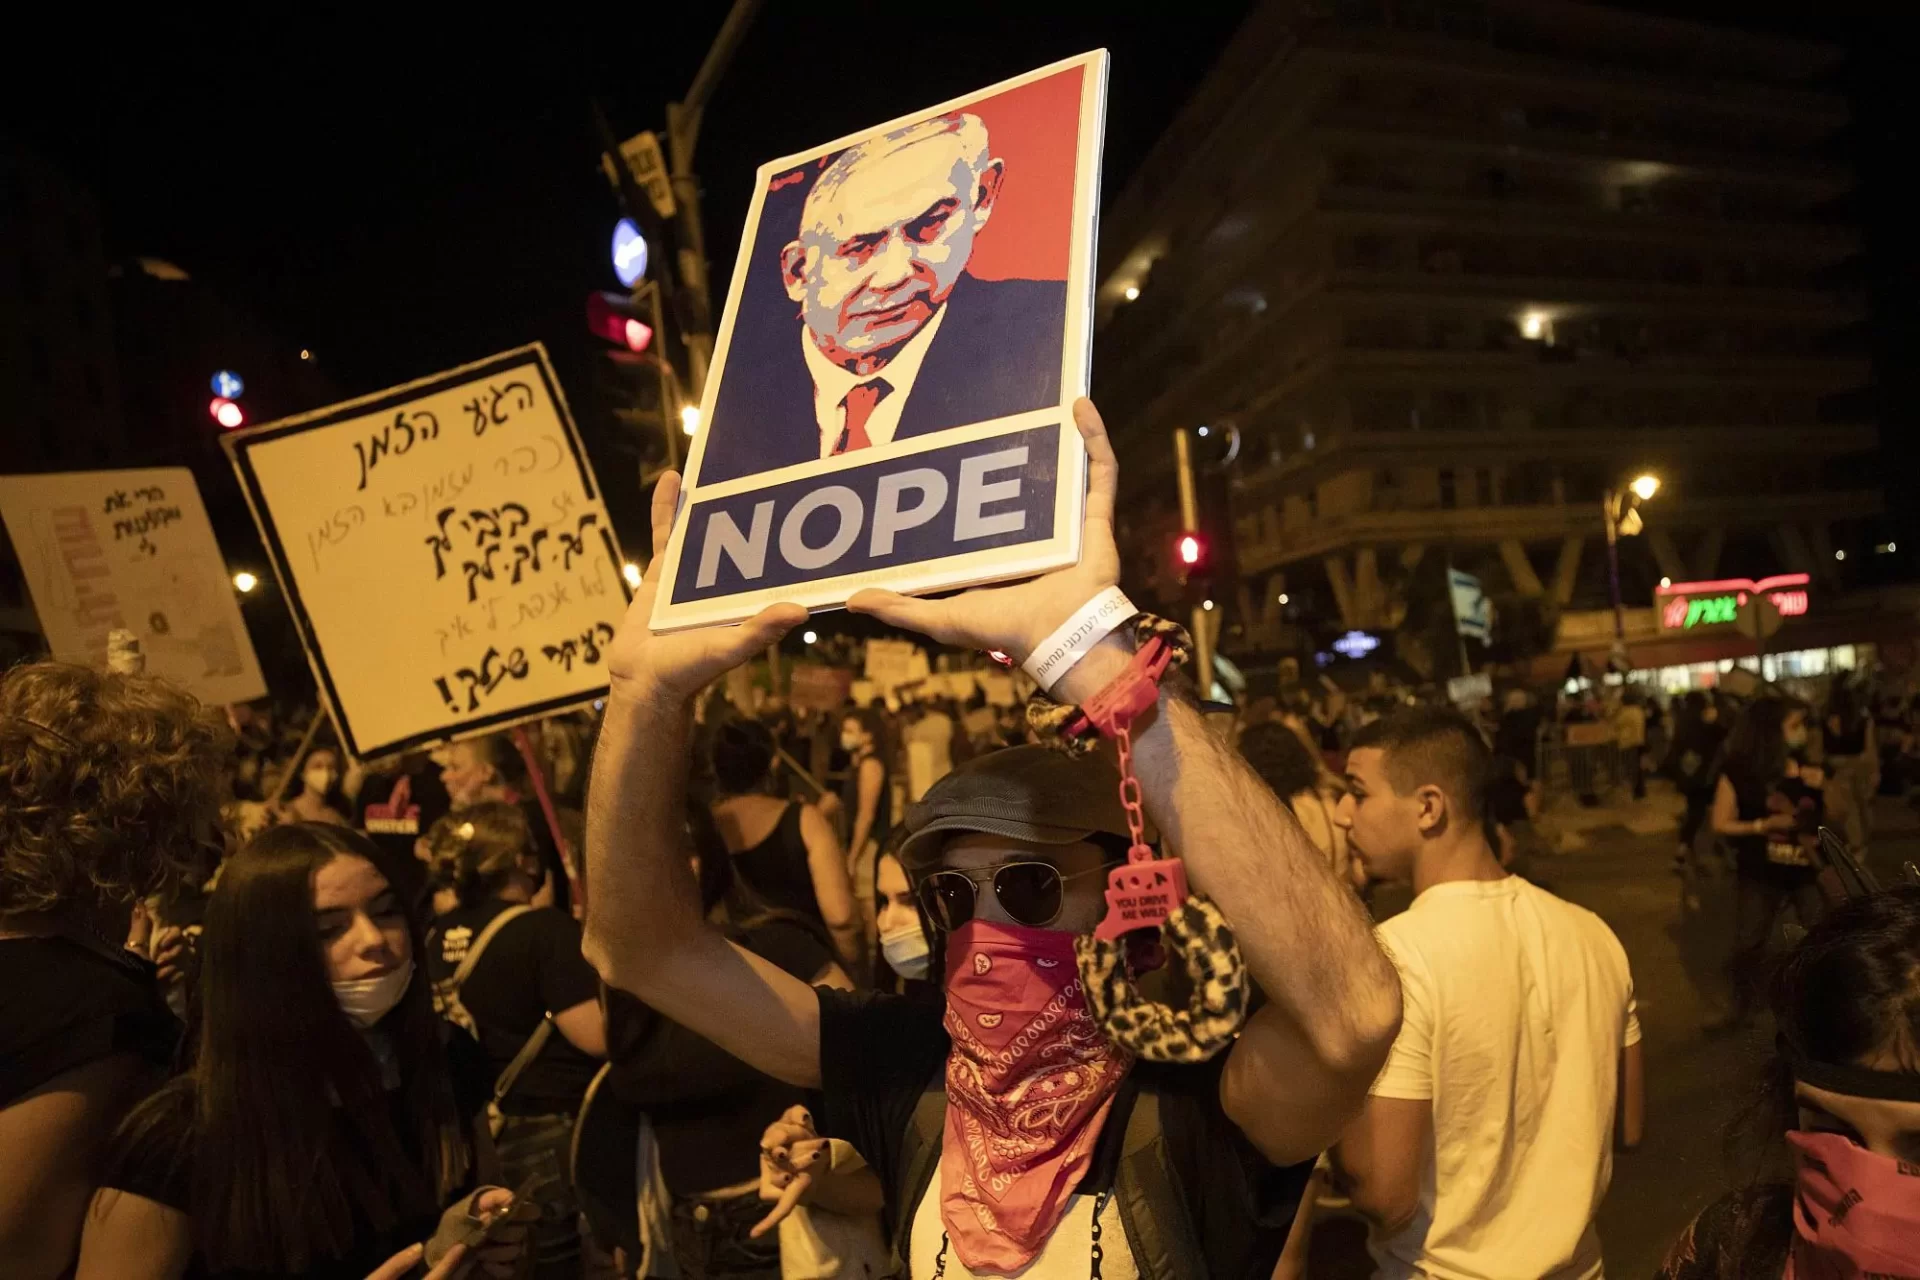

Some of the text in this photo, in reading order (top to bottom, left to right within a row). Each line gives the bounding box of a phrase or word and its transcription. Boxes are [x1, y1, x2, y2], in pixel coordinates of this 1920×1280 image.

[353, 381, 534, 492] הגיע הזמן
[695, 446, 1030, 589] NOPE
